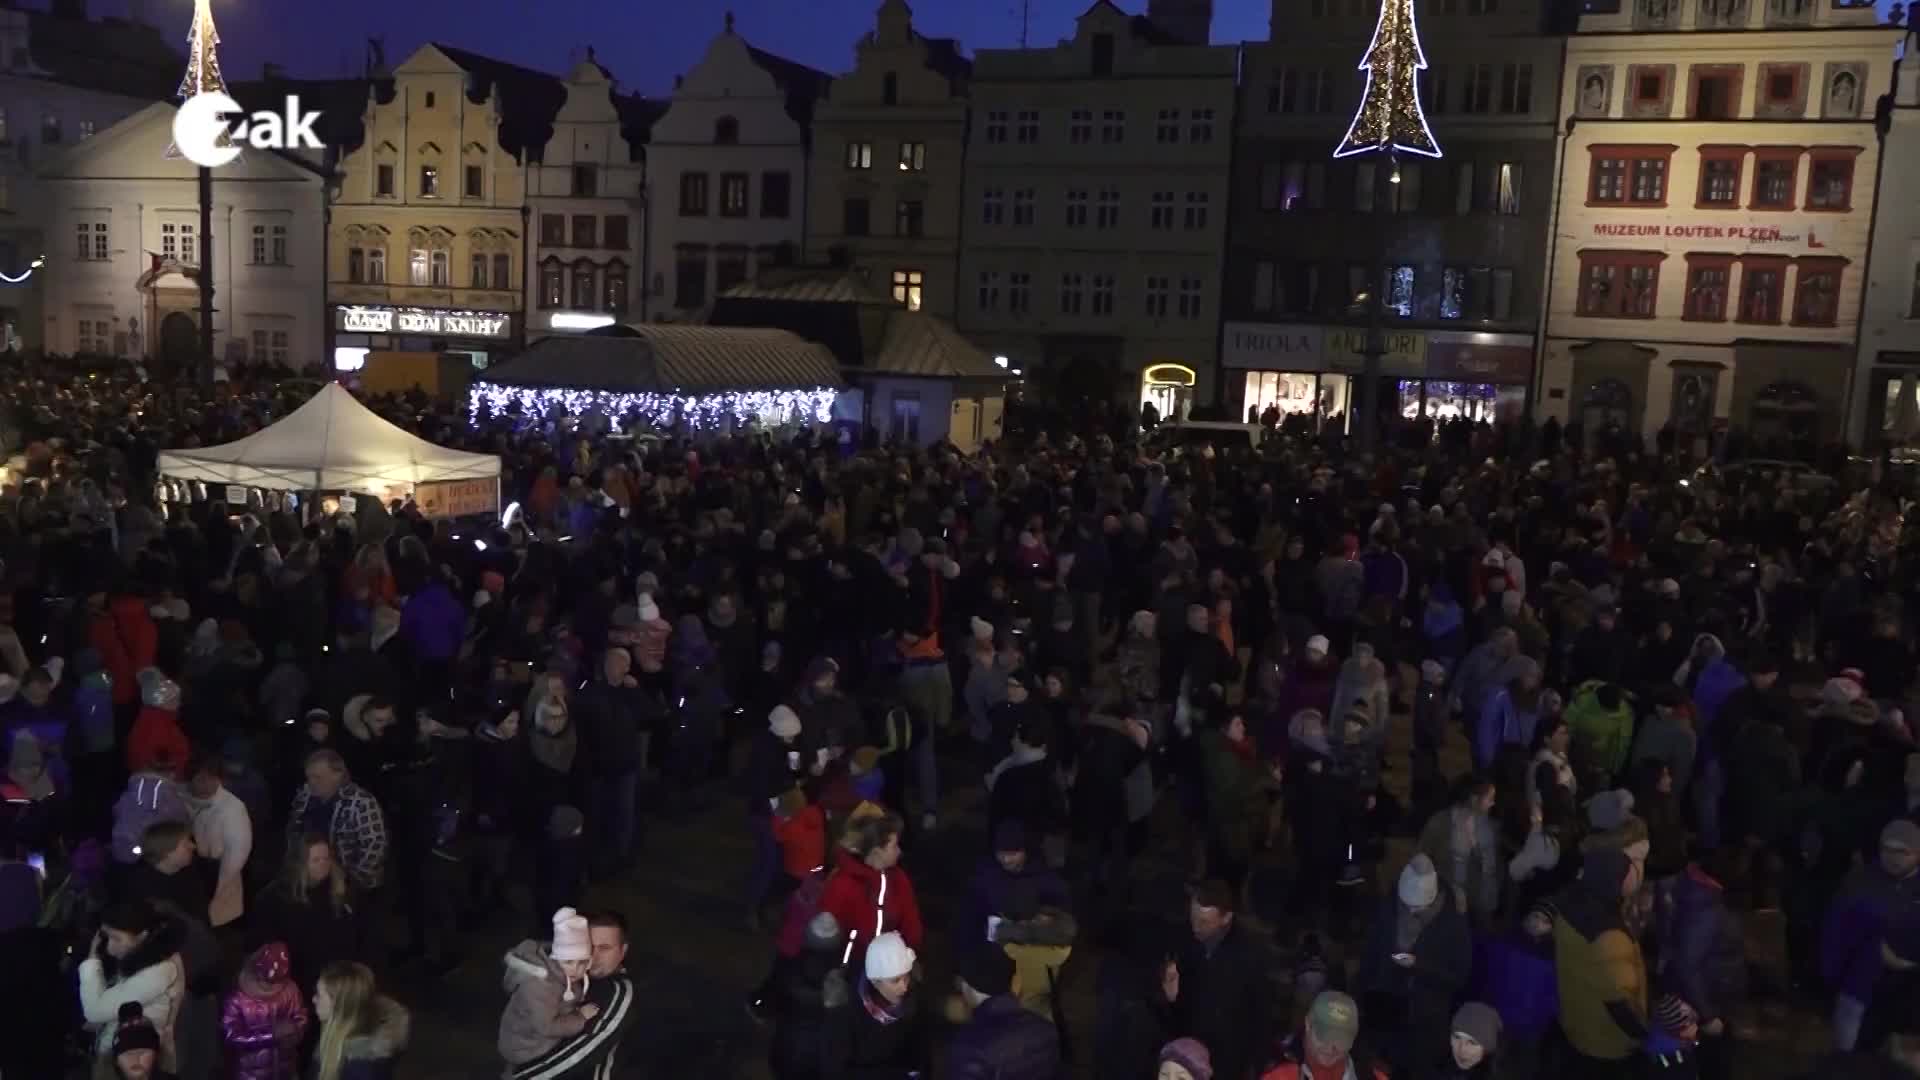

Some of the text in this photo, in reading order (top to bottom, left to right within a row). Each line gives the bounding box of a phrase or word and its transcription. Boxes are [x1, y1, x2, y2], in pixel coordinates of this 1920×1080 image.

[1594, 224, 1660, 236] MUZEUM
[1665, 226, 1723, 238] LOUTEK
[1234, 331, 1312, 353] TRIOLA
